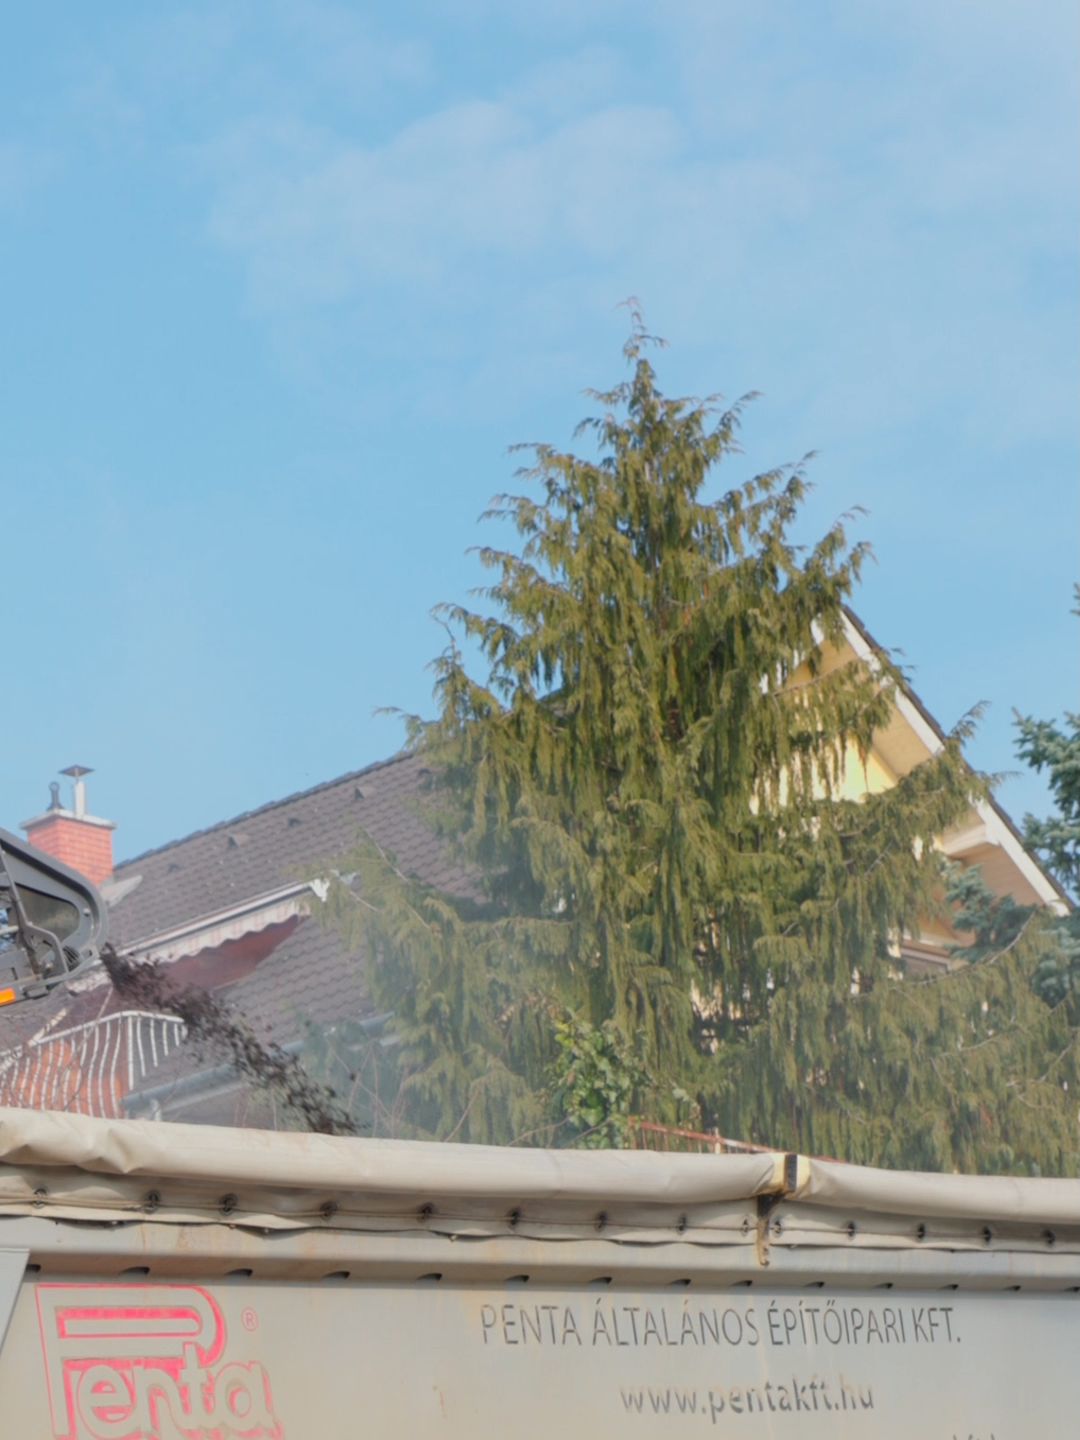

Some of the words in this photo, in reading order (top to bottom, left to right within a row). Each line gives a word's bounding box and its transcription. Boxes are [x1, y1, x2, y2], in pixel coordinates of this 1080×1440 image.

[480, 1304, 582, 1346] PENTA
[592, 1298, 760, 1346] ÁLTALÁNOS
[767, 1299, 906, 1345] ÉPÍTŐIPARI
[912, 1307, 962, 1343] KFT.
[619, 1372, 875, 1425] www.pentakft.hu
